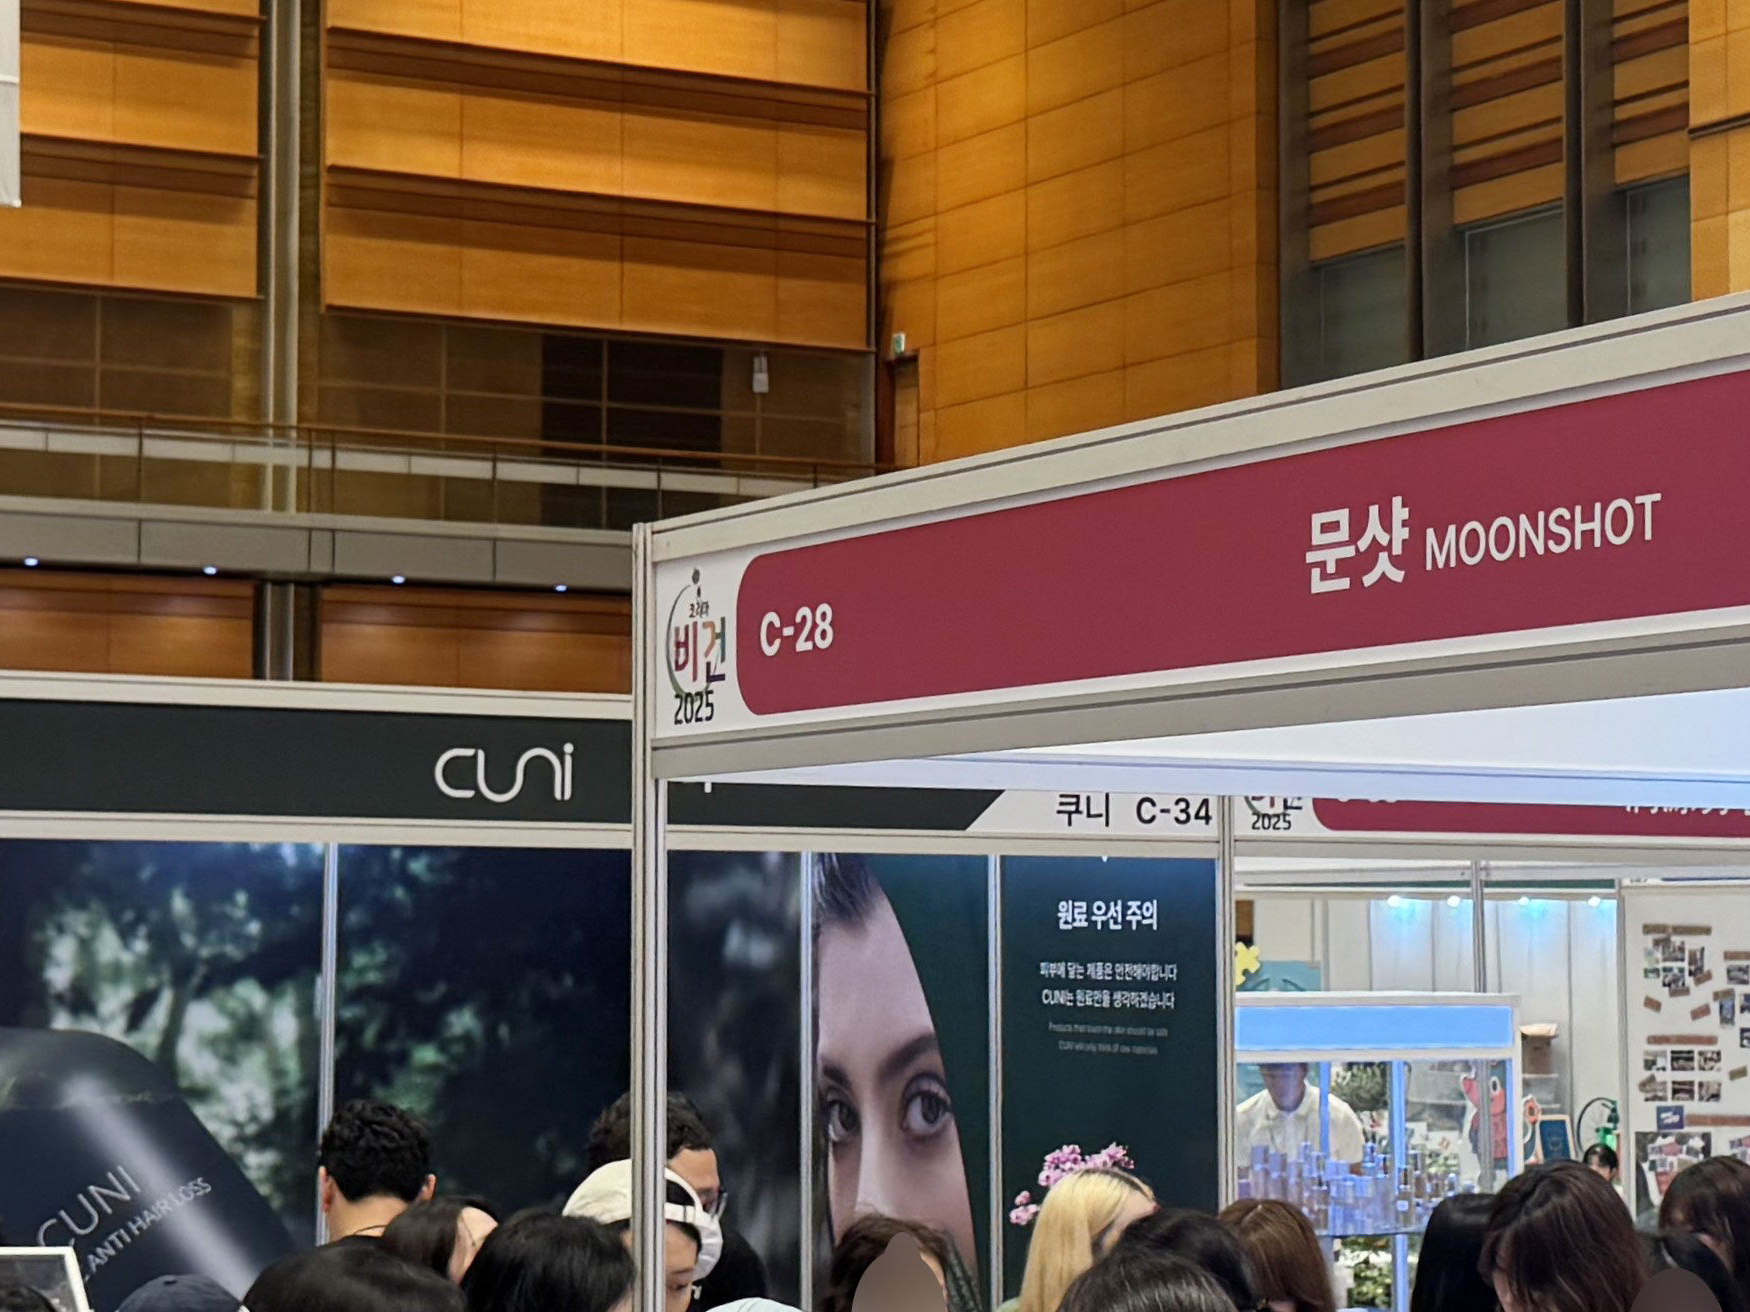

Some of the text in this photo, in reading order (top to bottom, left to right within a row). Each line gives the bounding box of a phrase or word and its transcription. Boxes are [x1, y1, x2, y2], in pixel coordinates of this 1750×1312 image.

[1305, 493, 1662, 594] 문샷 MOONSHOT
[674, 617, 726, 683] 비건
[760, 603, 834, 657] C-28
[674, 690, 714, 725] 2025
[1056, 792, 1109, 827] 쿠니
[1136, 796, 1212, 825] C-34
[1251, 813, 1292, 830] 2025
[1057, 899, 1157, 930] 원료 우선 주의
[1086, 961, 1113, 979] 제품은
[37, 1165, 141, 1247] CUNI
[87, 1177, 212, 1273] ANTI HAIR LOSS
